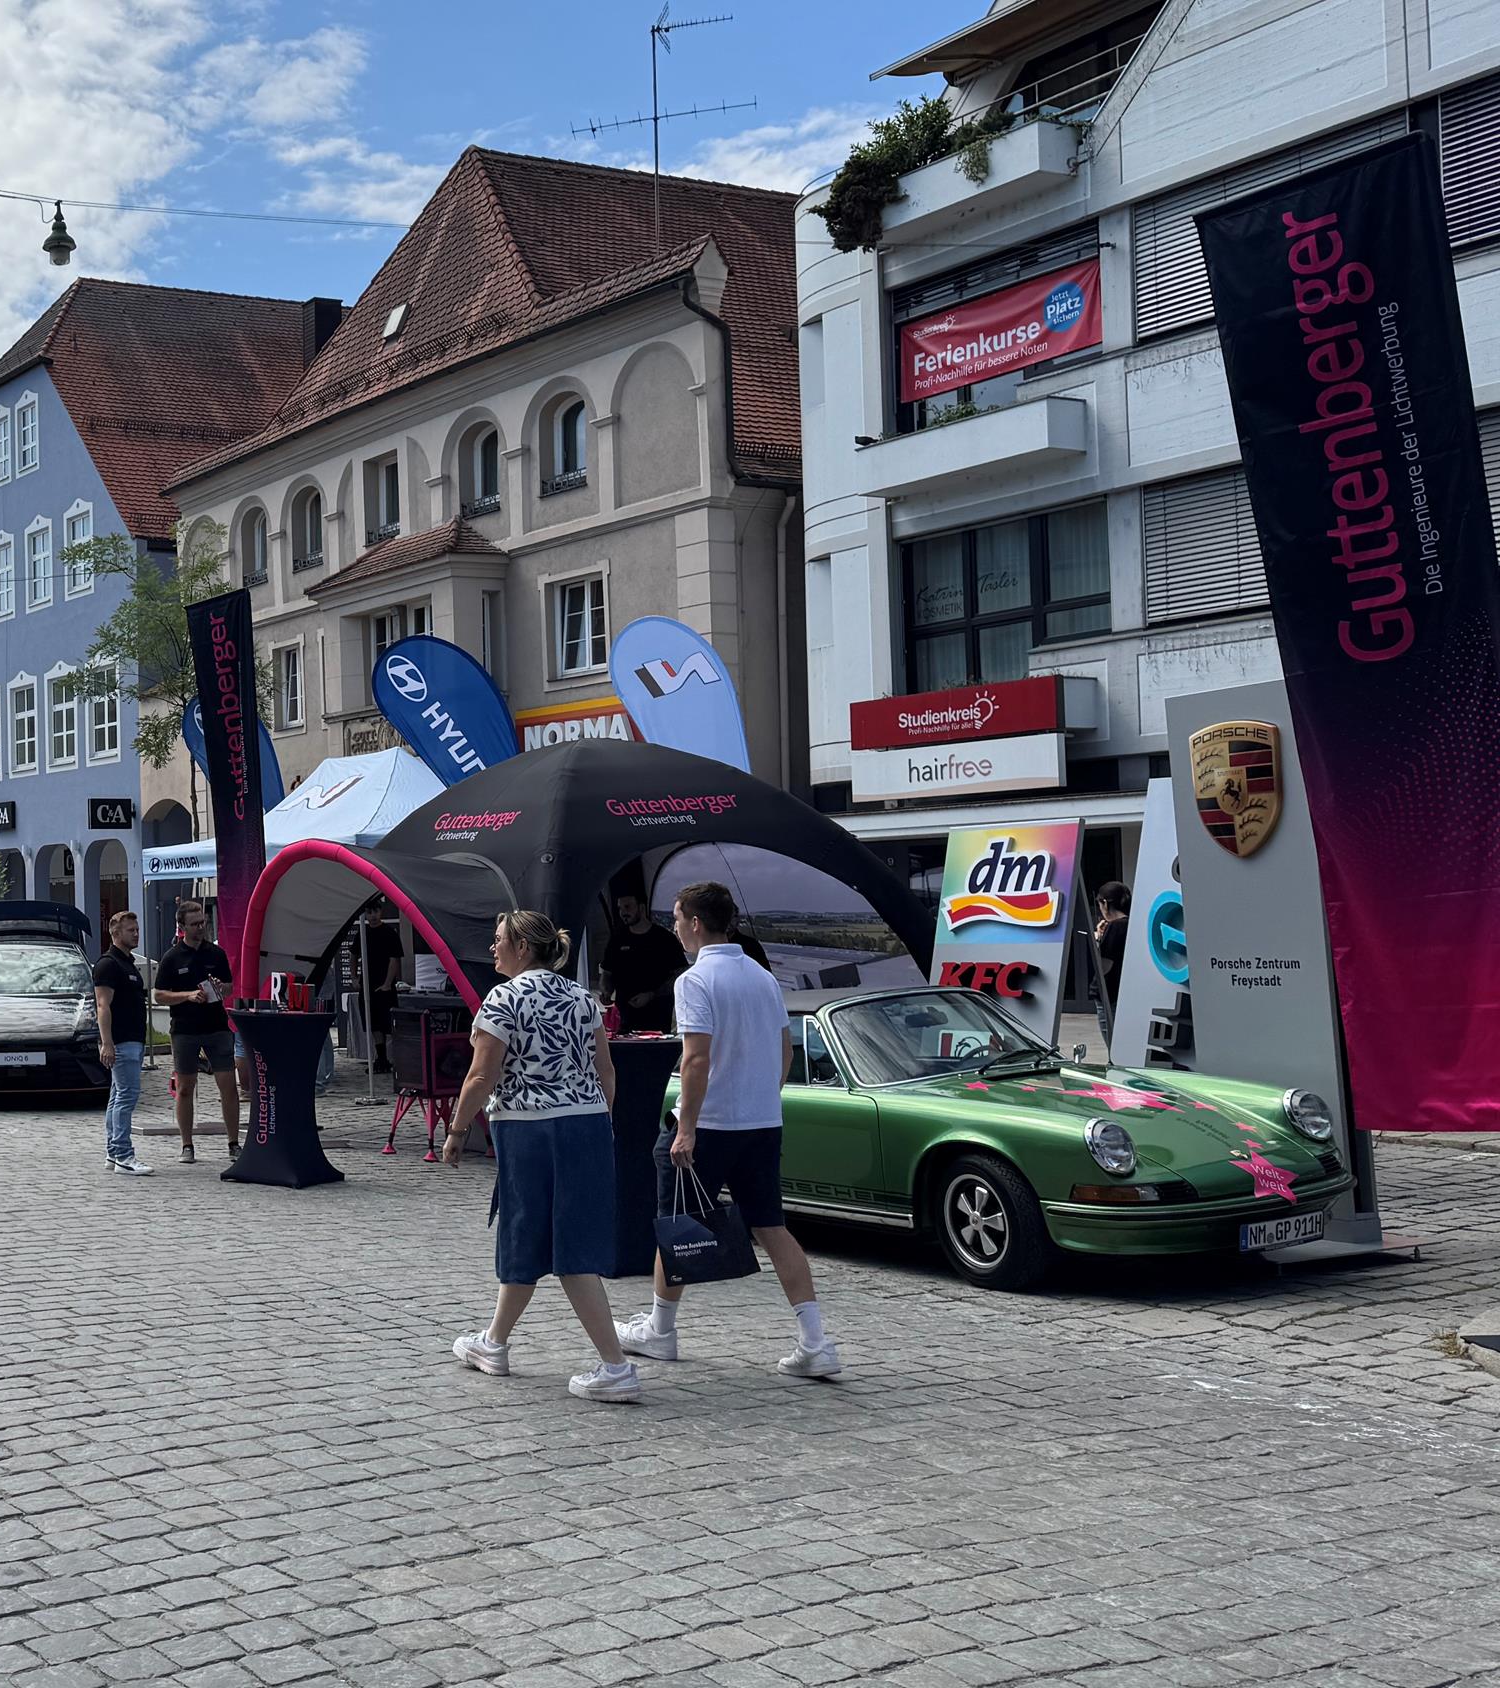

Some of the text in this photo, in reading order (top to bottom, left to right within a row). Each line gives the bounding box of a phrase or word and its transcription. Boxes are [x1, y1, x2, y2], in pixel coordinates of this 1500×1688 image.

[1051, 290, 1069, 301] Jetzt
[1046, 296, 1081, 319] Platz
[1053, 310, 1080, 324] sichern
[914, 321, 1041, 377] Ferienkurse
[914, 342, 1048, 390] Profi-Nachhilfe für bessere Noten
[1282, 211, 1415, 661] Guttenberger
[1378, 302, 1443, 594] Die Ingenieure der Lichtwerbung
[208, 612, 245, 821] Guttenberger
[898, 704, 981, 728] Studienkreis
[524, 713, 629, 752] NORMA
[1192, 726, 1269, 749] PORSCHE
[908, 754, 993, 783] hairfree
[96, 804, 127, 823] C&A
[605, 792, 737, 817] Guttenberger
[434, 808, 521, 831] Guttenberger
[631, 814, 696, 827] Lichtwerbung
[435, 830, 479, 841] Lichtwerbung
[163, 856, 200, 870] HYUNDAI
[968, 841, 1046, 894] dm
[1211, 957, 1301, 970] Porsche Zentrum
[938, 961, 1028, 998] KFC
[1231, 974, 1282, 989] Freystadt
[4, 1055, 23, 1063] IONIQ
[253, 1048, 268, 1145] Guttenberger
[269, 1085, 277, 1135] Lichtwerbung
[1250, 1164, 1285, 1181] Welt-
[1258, 1178, 1286, 1193] weit
[1249, 1225, 1266, 1246] NM
[1275, 1220, 1291, 1241] GP
[1294, 1214, 1322, 1237] 911H
